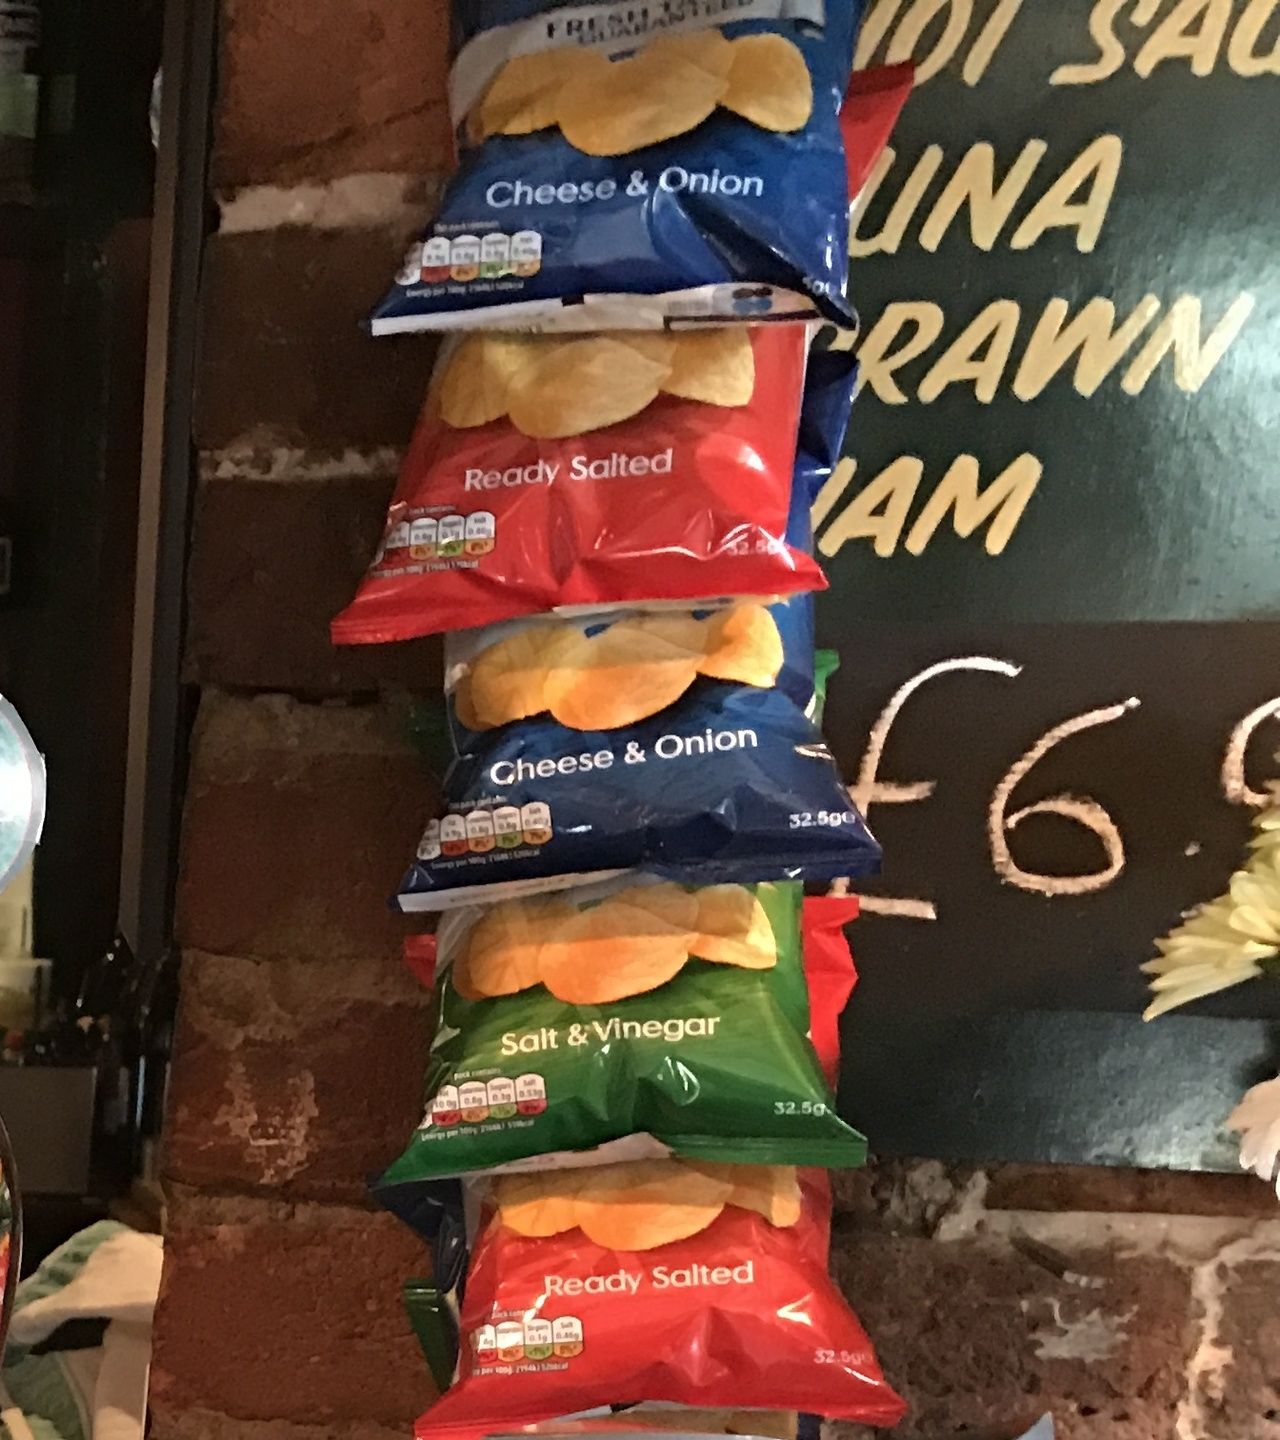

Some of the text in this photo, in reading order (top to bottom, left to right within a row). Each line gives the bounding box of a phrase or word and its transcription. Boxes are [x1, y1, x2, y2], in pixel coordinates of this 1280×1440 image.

[485, 166, 764, 209] Cheese & Onion
[849, 134, 1123, 257] UNA
[463, 448, 674, 493] Ready Salted
[489, 725, 759, 787] Cheese & Onion
[500, 1013, 722, 1057] Salt & Vinegar
[544, 1259, 756, 1299] Ready Salted
